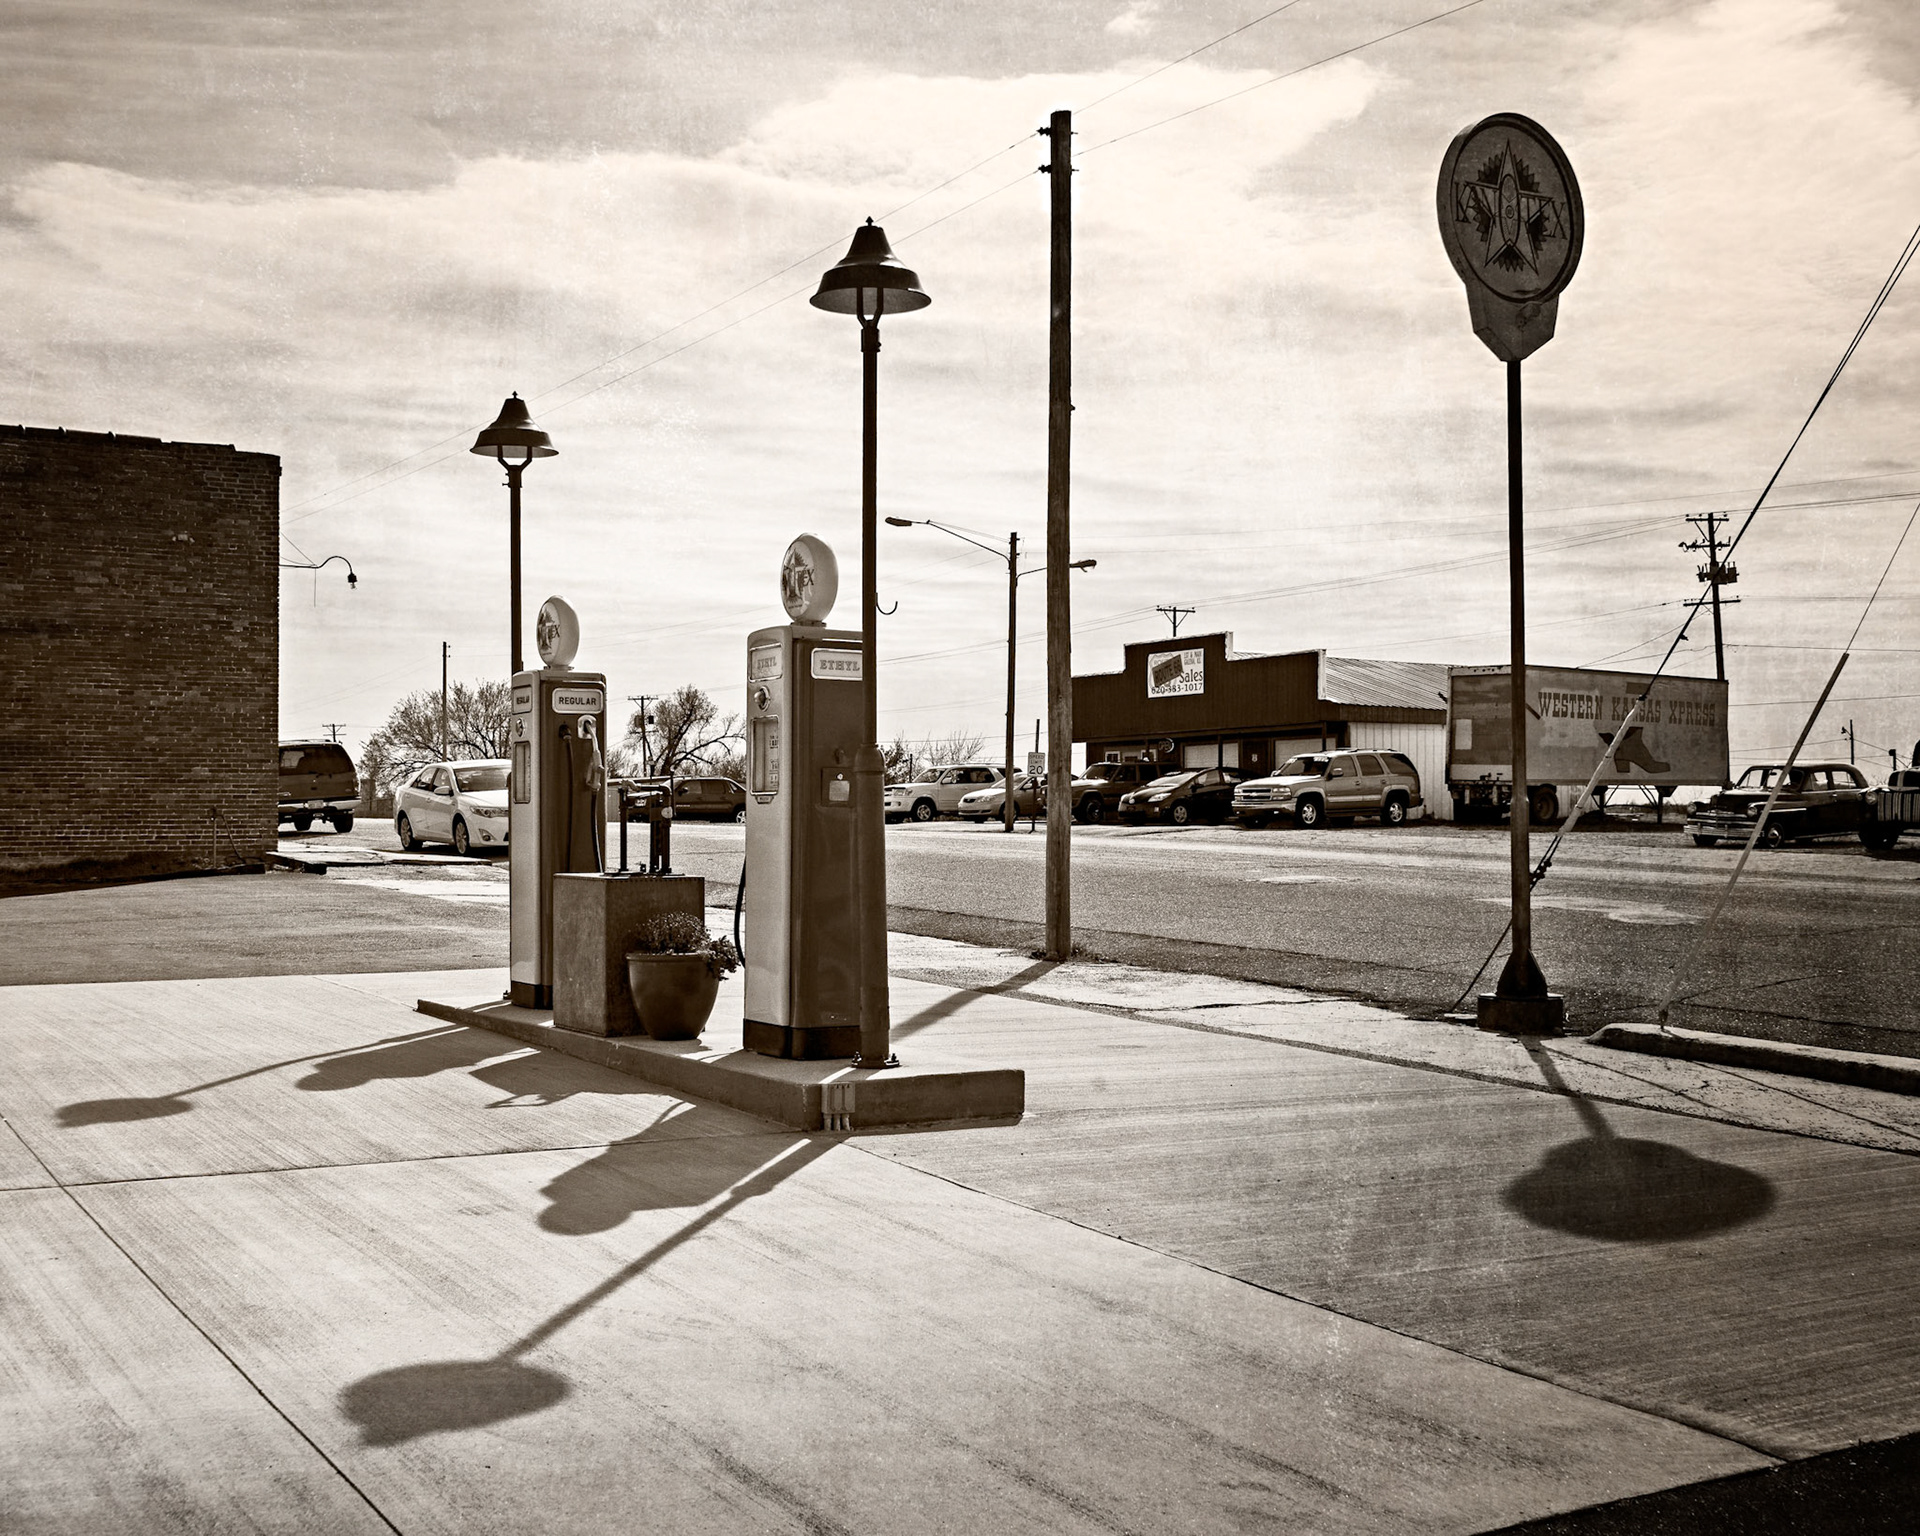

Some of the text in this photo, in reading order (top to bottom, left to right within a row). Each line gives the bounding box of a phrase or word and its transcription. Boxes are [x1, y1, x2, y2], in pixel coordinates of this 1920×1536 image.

[819, 659, 861, 672] ETHYL
[1179, 669, 1203, 684] Sales
[558, 696, 597, 706] REGULAR
[1538, 691, 1603, 720] WESTERN
[1668, 700, 1716, 727] XPRESS
[1029, 765, 1044, 775] 20
